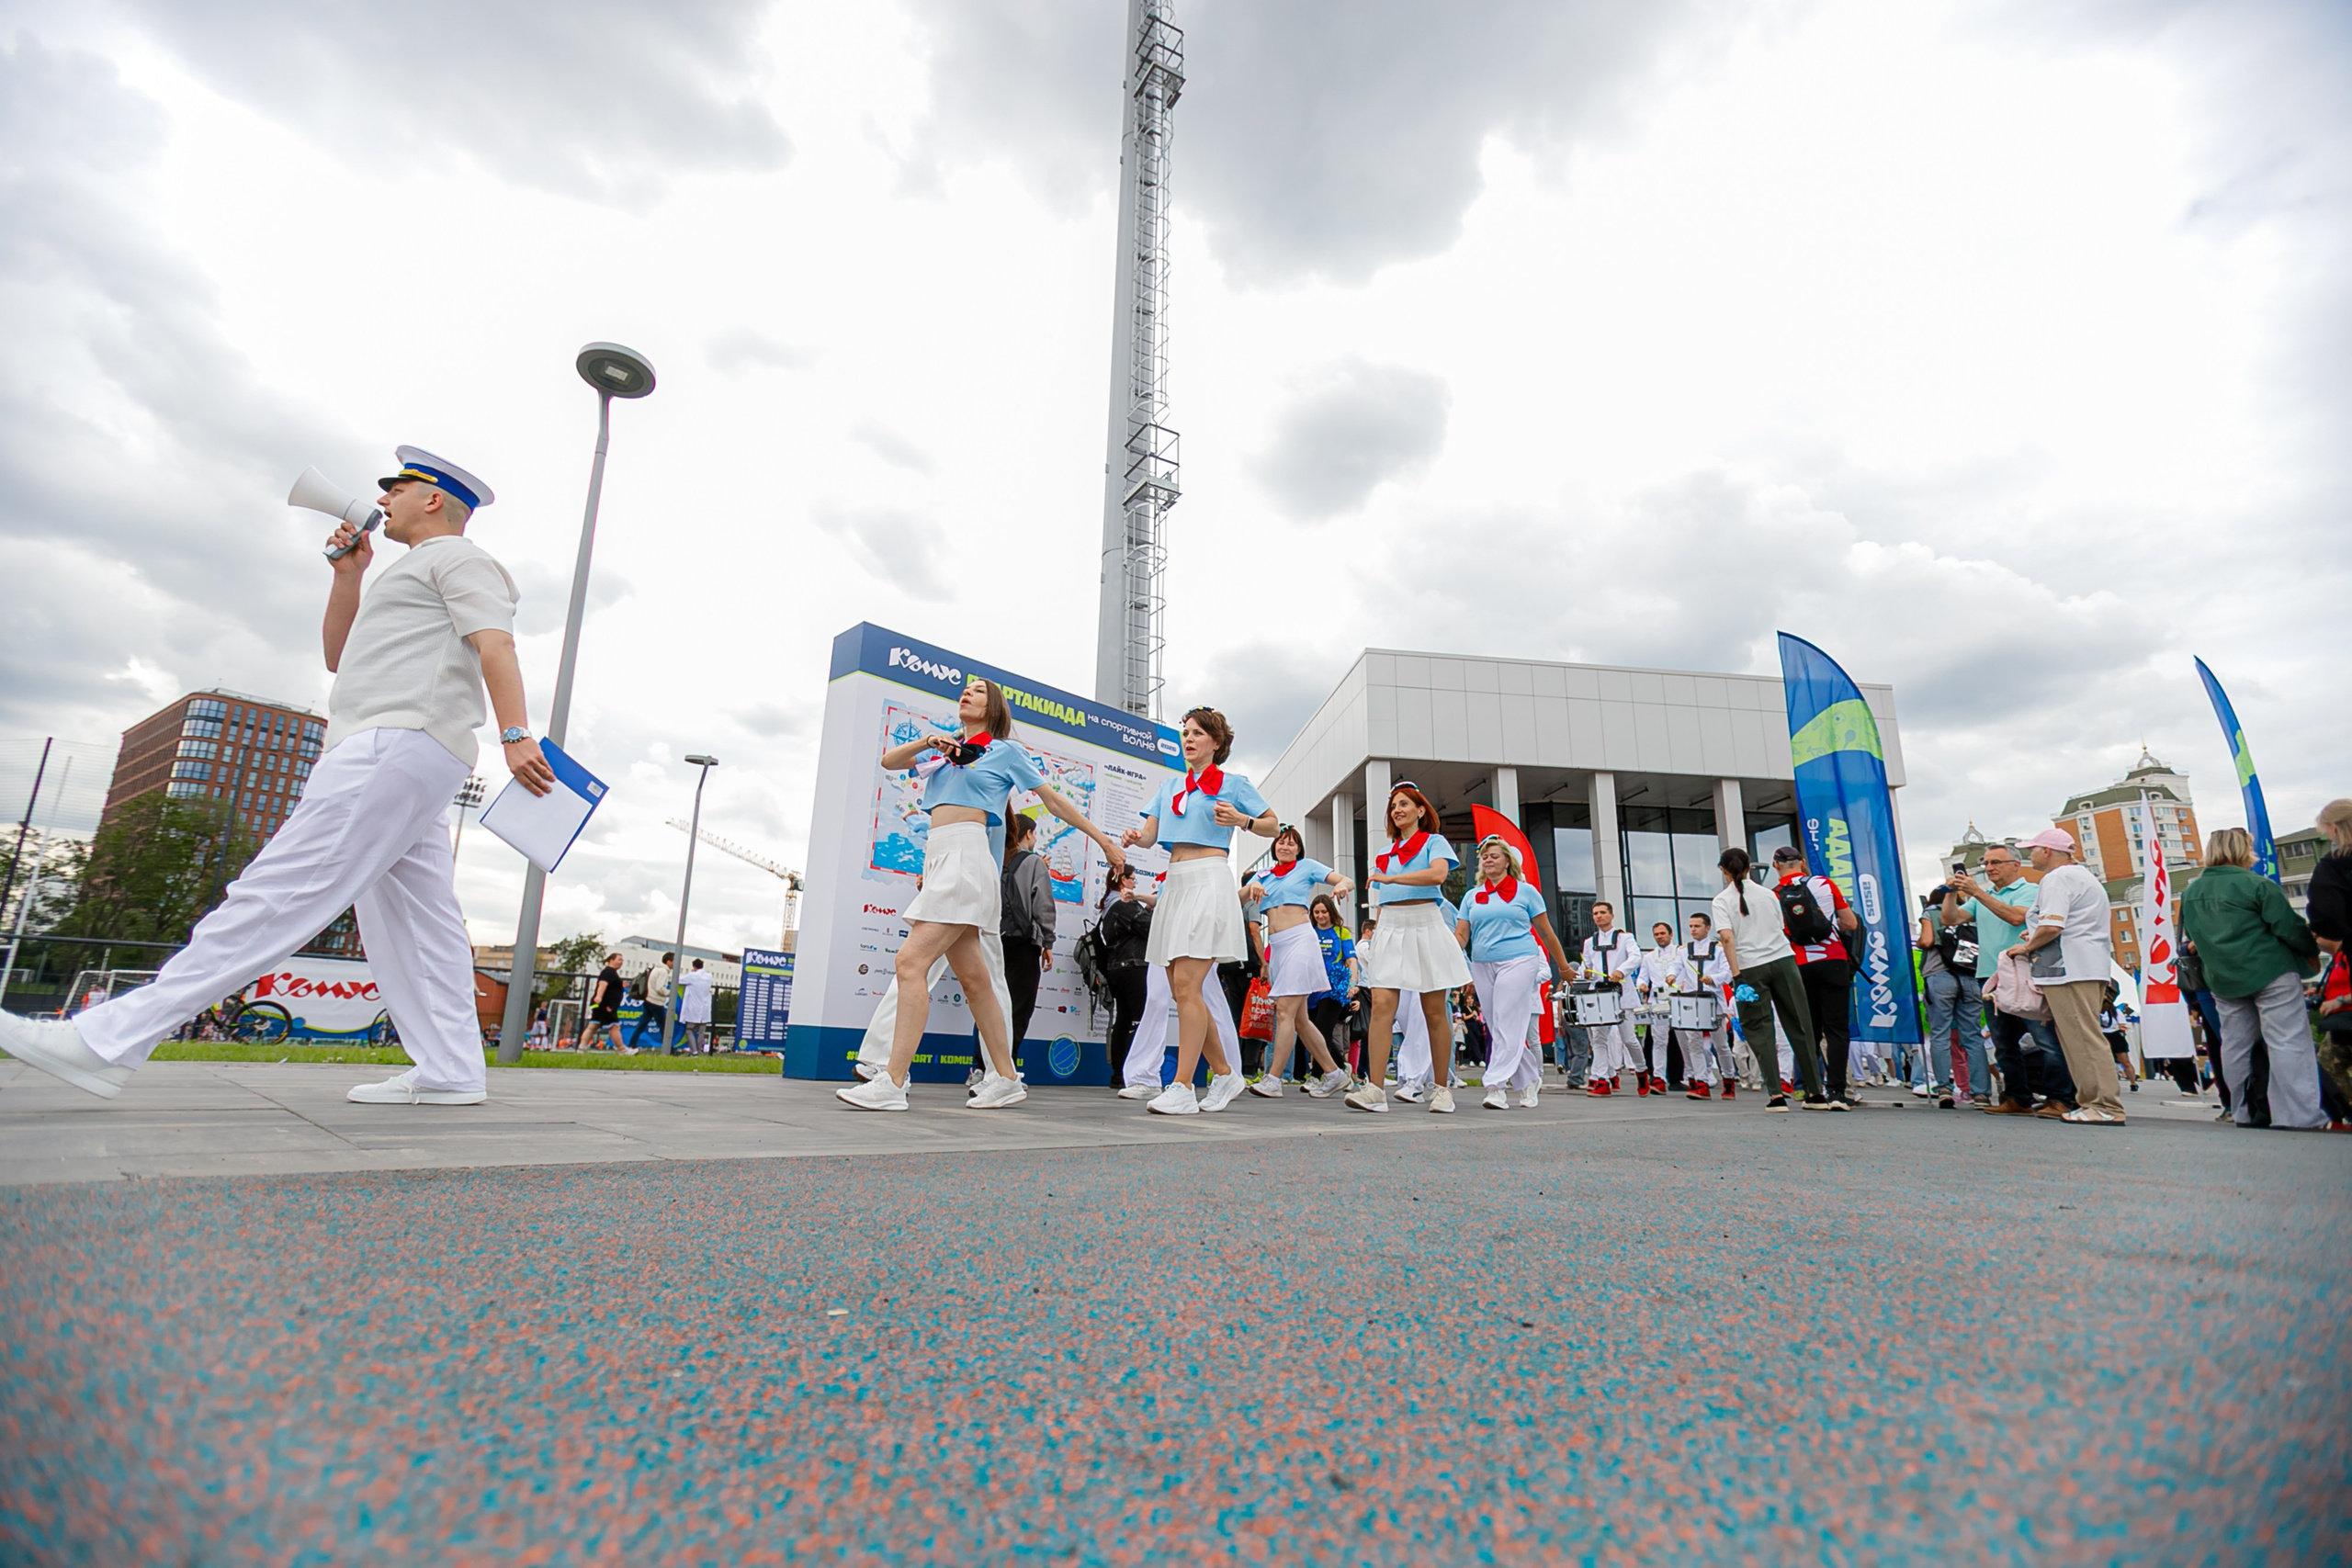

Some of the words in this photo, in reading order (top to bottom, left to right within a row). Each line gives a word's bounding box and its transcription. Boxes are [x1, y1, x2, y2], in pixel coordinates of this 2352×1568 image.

[1087, 713, 1099, 724] на
[1101, 716, 1153, 742] спортивной
[1122, 733, 1156, 751] волне
